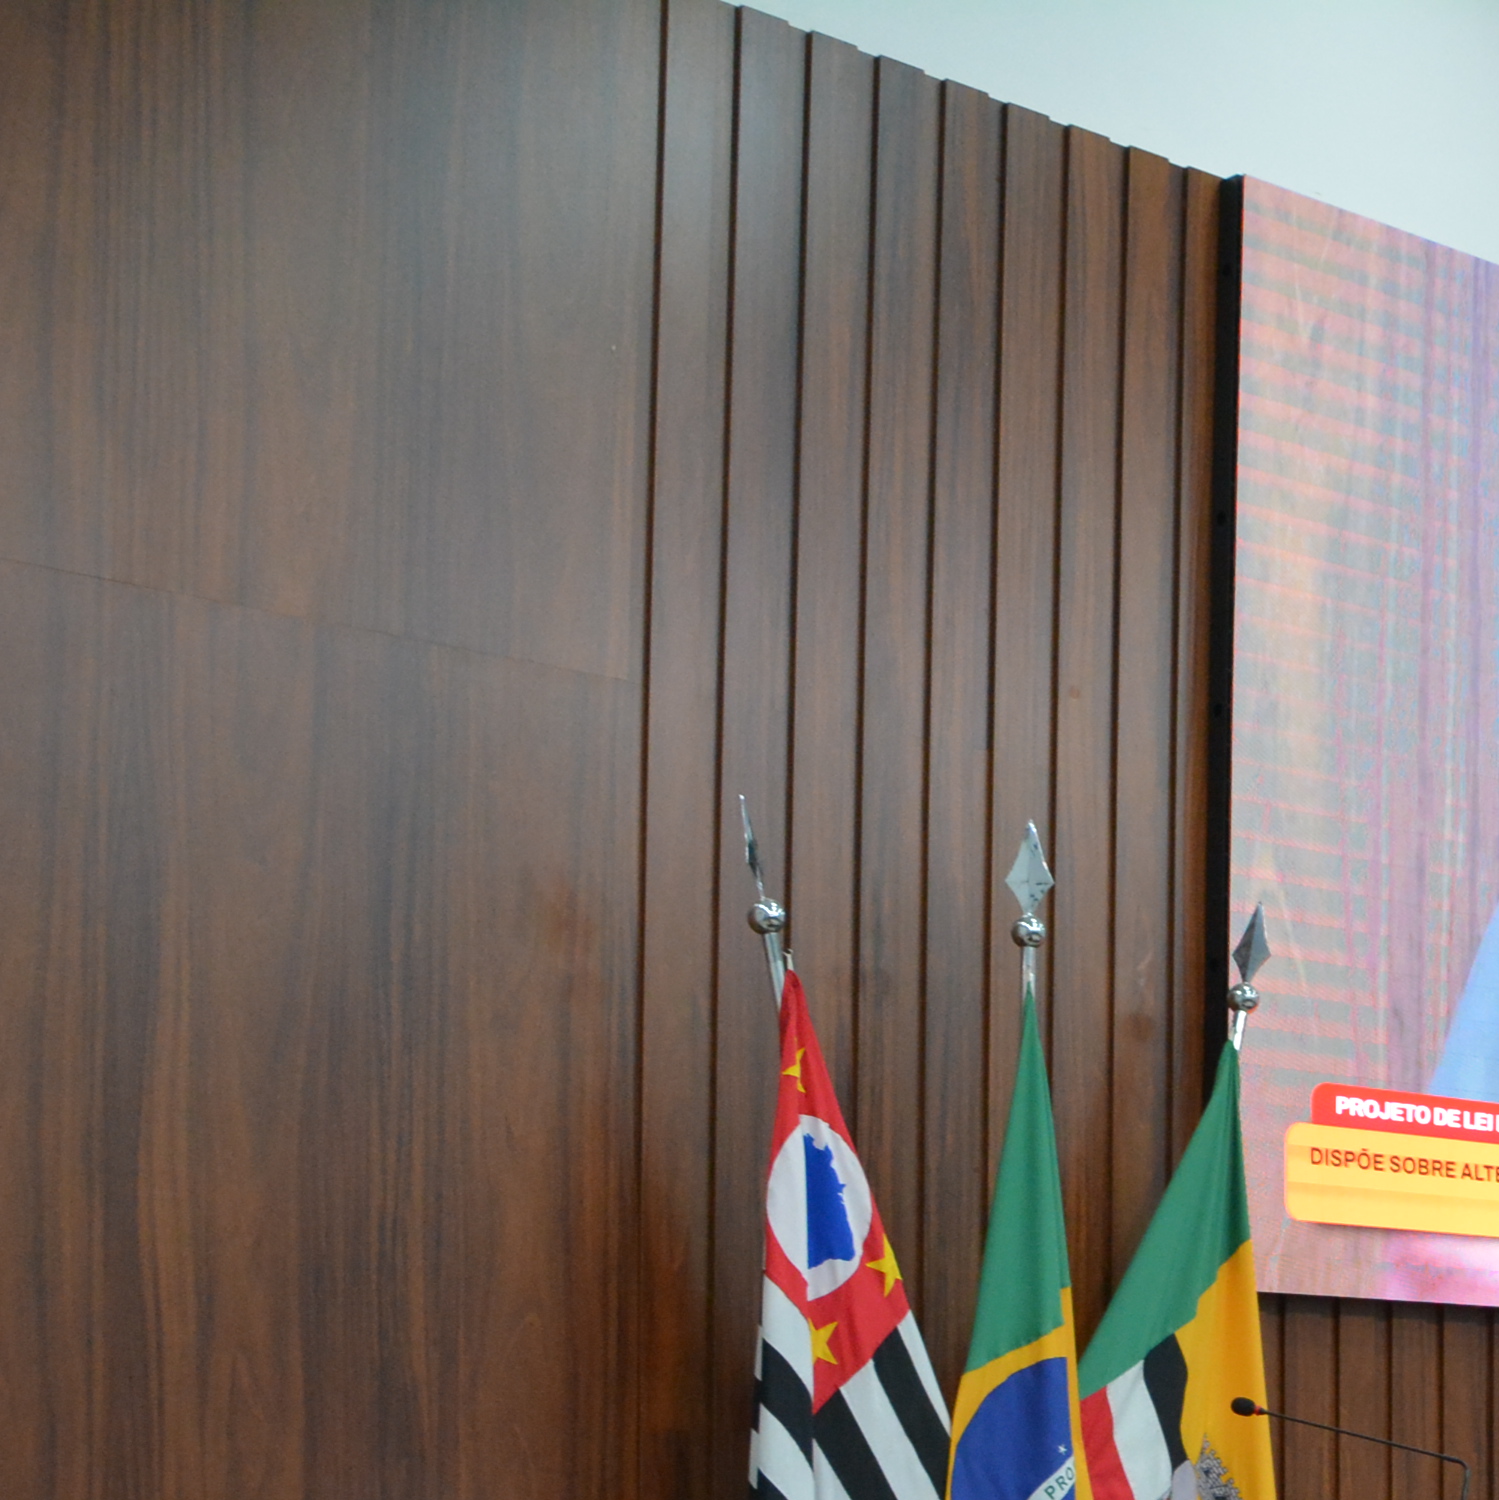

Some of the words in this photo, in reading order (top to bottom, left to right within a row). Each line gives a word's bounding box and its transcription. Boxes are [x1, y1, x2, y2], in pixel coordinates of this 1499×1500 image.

[1335, 1095, 1431, 1124] PROJETO
[1433, 1107, 1461, 1128] DE
[1463, 1111, 1494, 1132] LEI
[1310, 1147, 1384, 1172] DISPÕE
[1390, 1155, 1457, 1179] SOBRE
